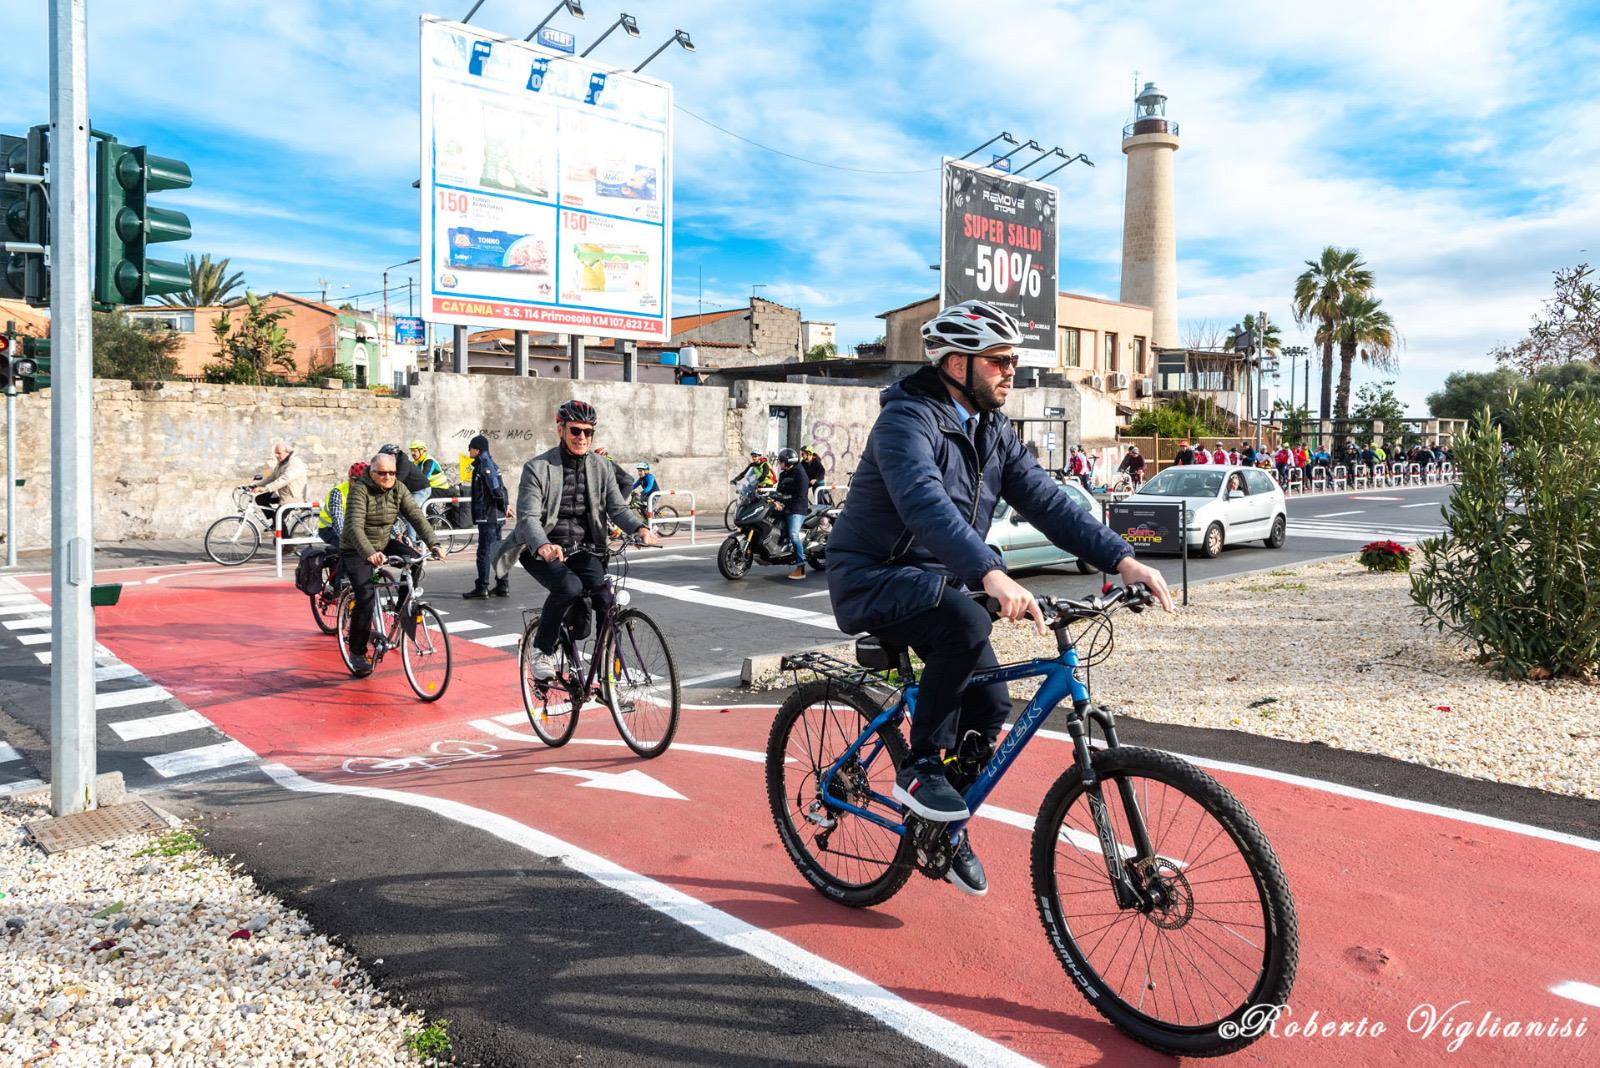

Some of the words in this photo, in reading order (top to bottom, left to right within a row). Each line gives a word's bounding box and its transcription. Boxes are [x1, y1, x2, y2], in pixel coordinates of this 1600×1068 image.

[983, 190, 1024, 209] REMOVE
[963, 213, 1004, 245] SUPER
[1008, 221, 1042, 251] SALDI
[965, 245, 1041, 298] -50%
[441, 301, 494, 316] CATANIA
[503, 307, 522, 318] S.S.
[525, 309, 539, 319] 114
[541, 310, 591, 324] Primosole
[592, 316, 608, 326] KM
[1121, 534, 1162, 543] Gomme
[983, 697, 1043, 778] TREK
[1041, 896, 1100, 999] SCHWALBE
